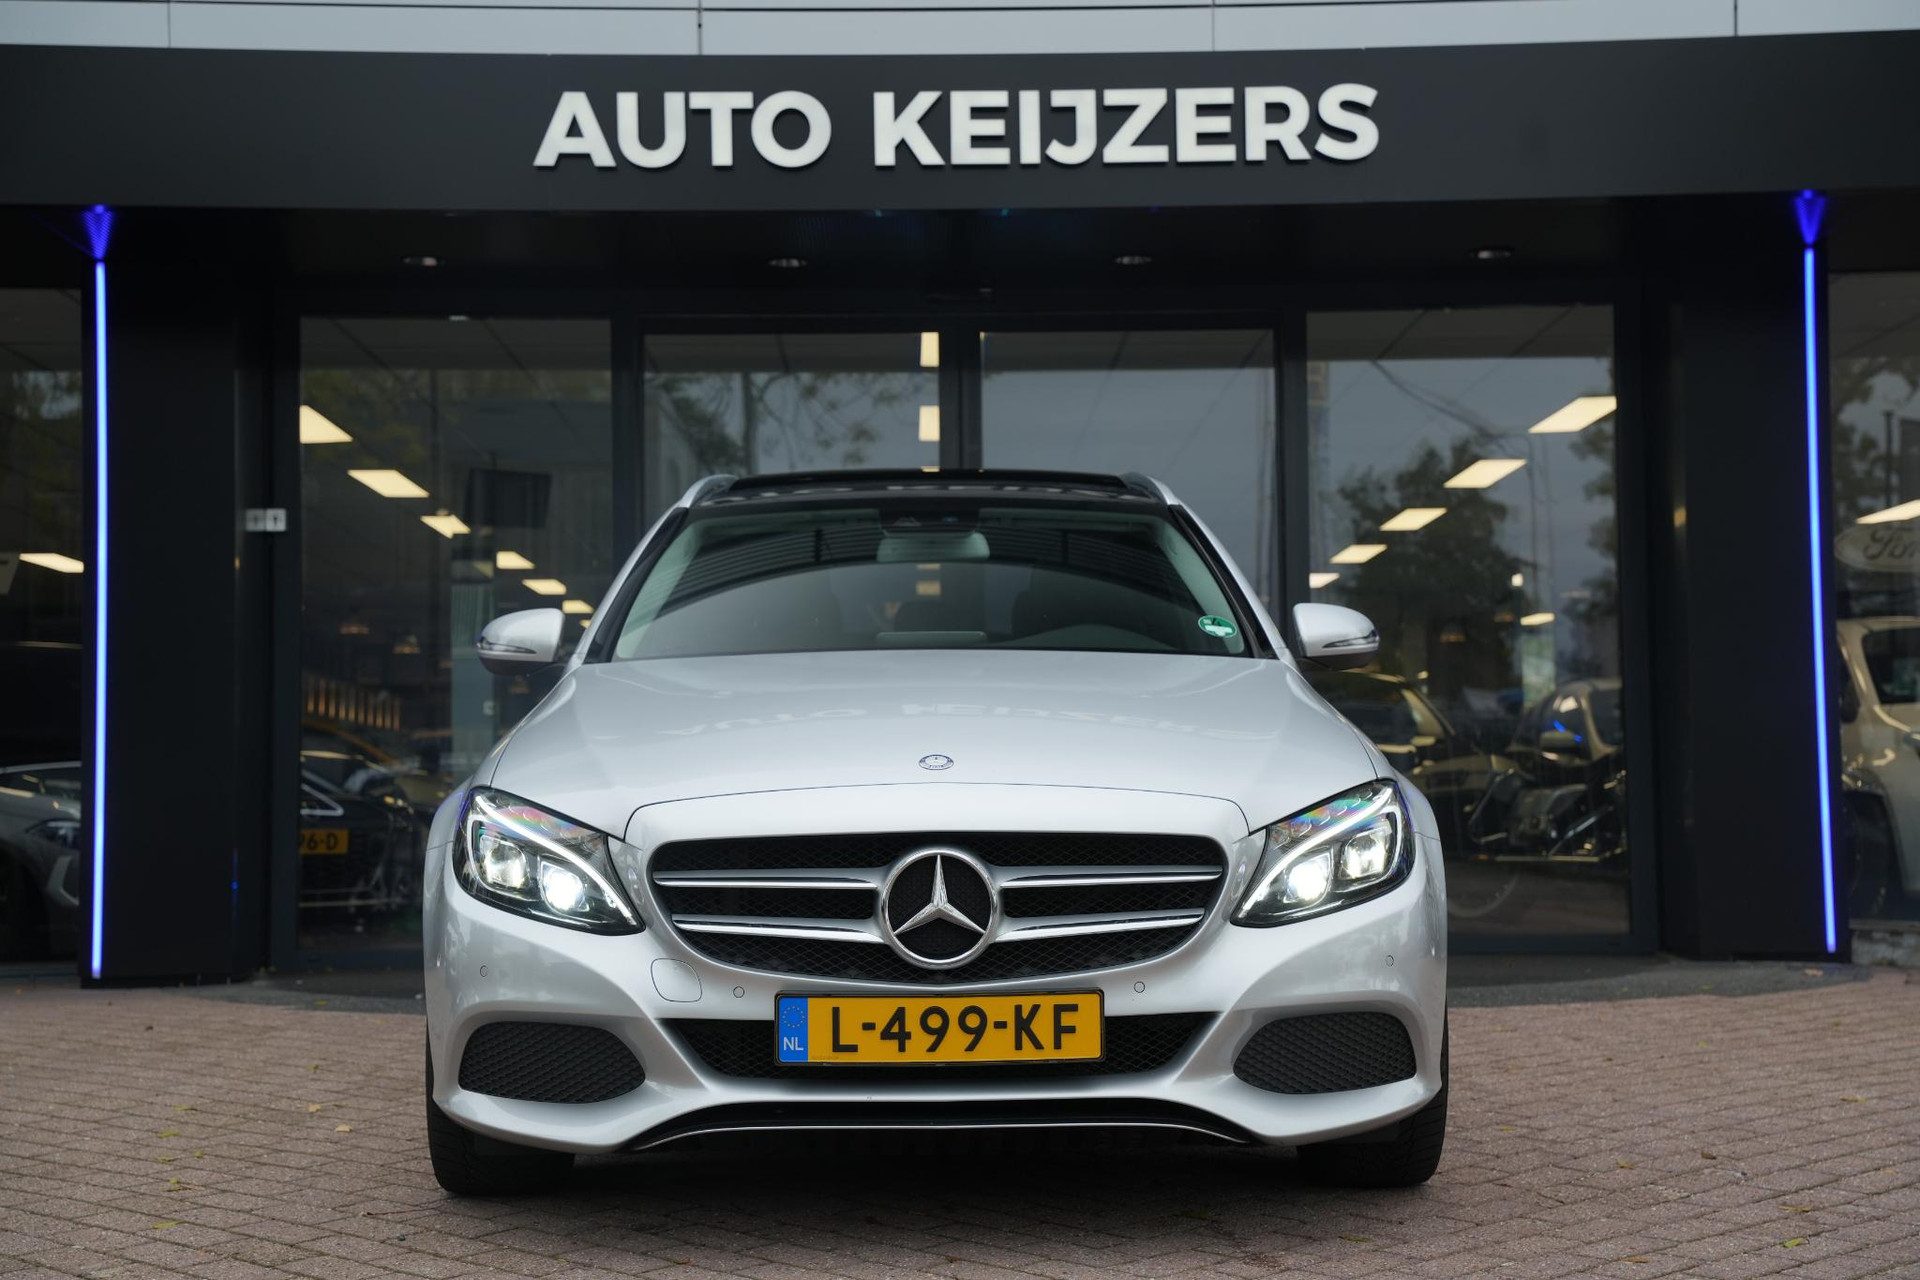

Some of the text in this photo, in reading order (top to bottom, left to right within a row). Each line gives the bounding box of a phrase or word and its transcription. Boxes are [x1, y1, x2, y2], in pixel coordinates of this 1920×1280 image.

[534, 83, 1379, 168] AUTO KEIJZERS
[783, 1037, 804, 1051] NL
[832, 1003, 1079, 1053] L-499-KF
